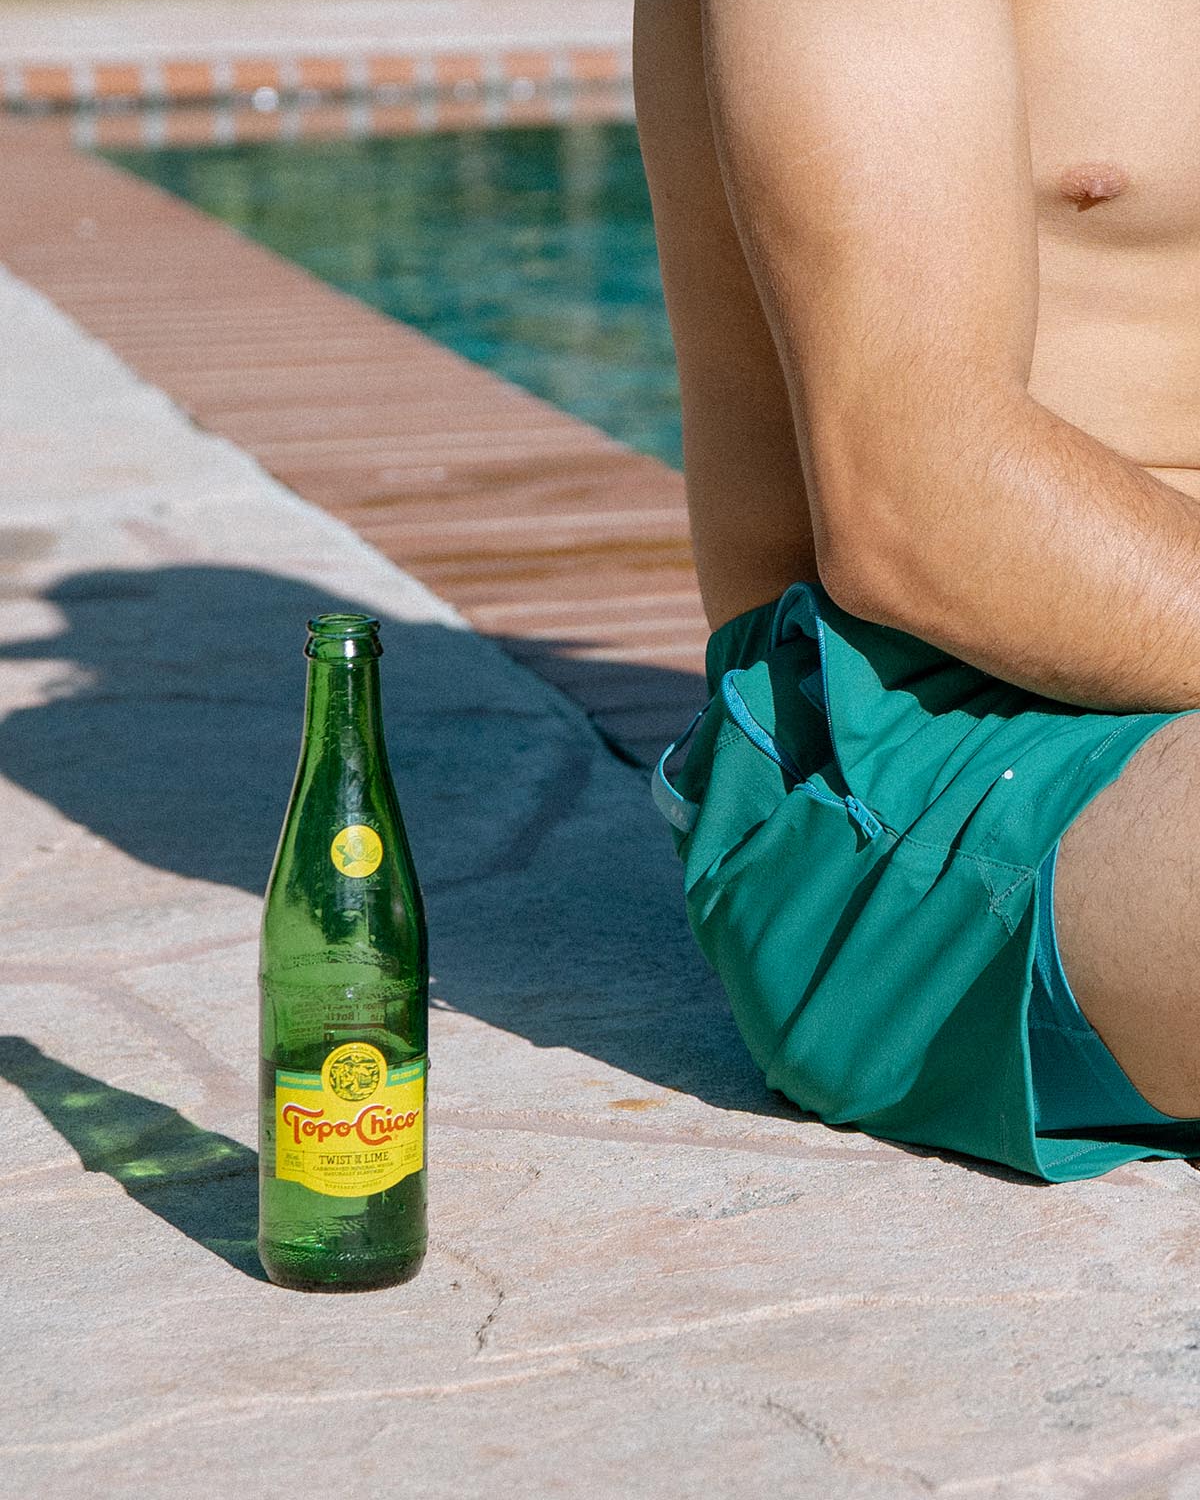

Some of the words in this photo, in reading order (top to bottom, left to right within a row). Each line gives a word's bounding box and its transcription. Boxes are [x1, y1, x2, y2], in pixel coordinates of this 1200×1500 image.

[282, 1103, 353, 1145] Topo
[354, 1103, 419, 1146] Chico
[319, 1155, 352, 1165] TWIST
[364, 1151, 389, 1164] LIME
